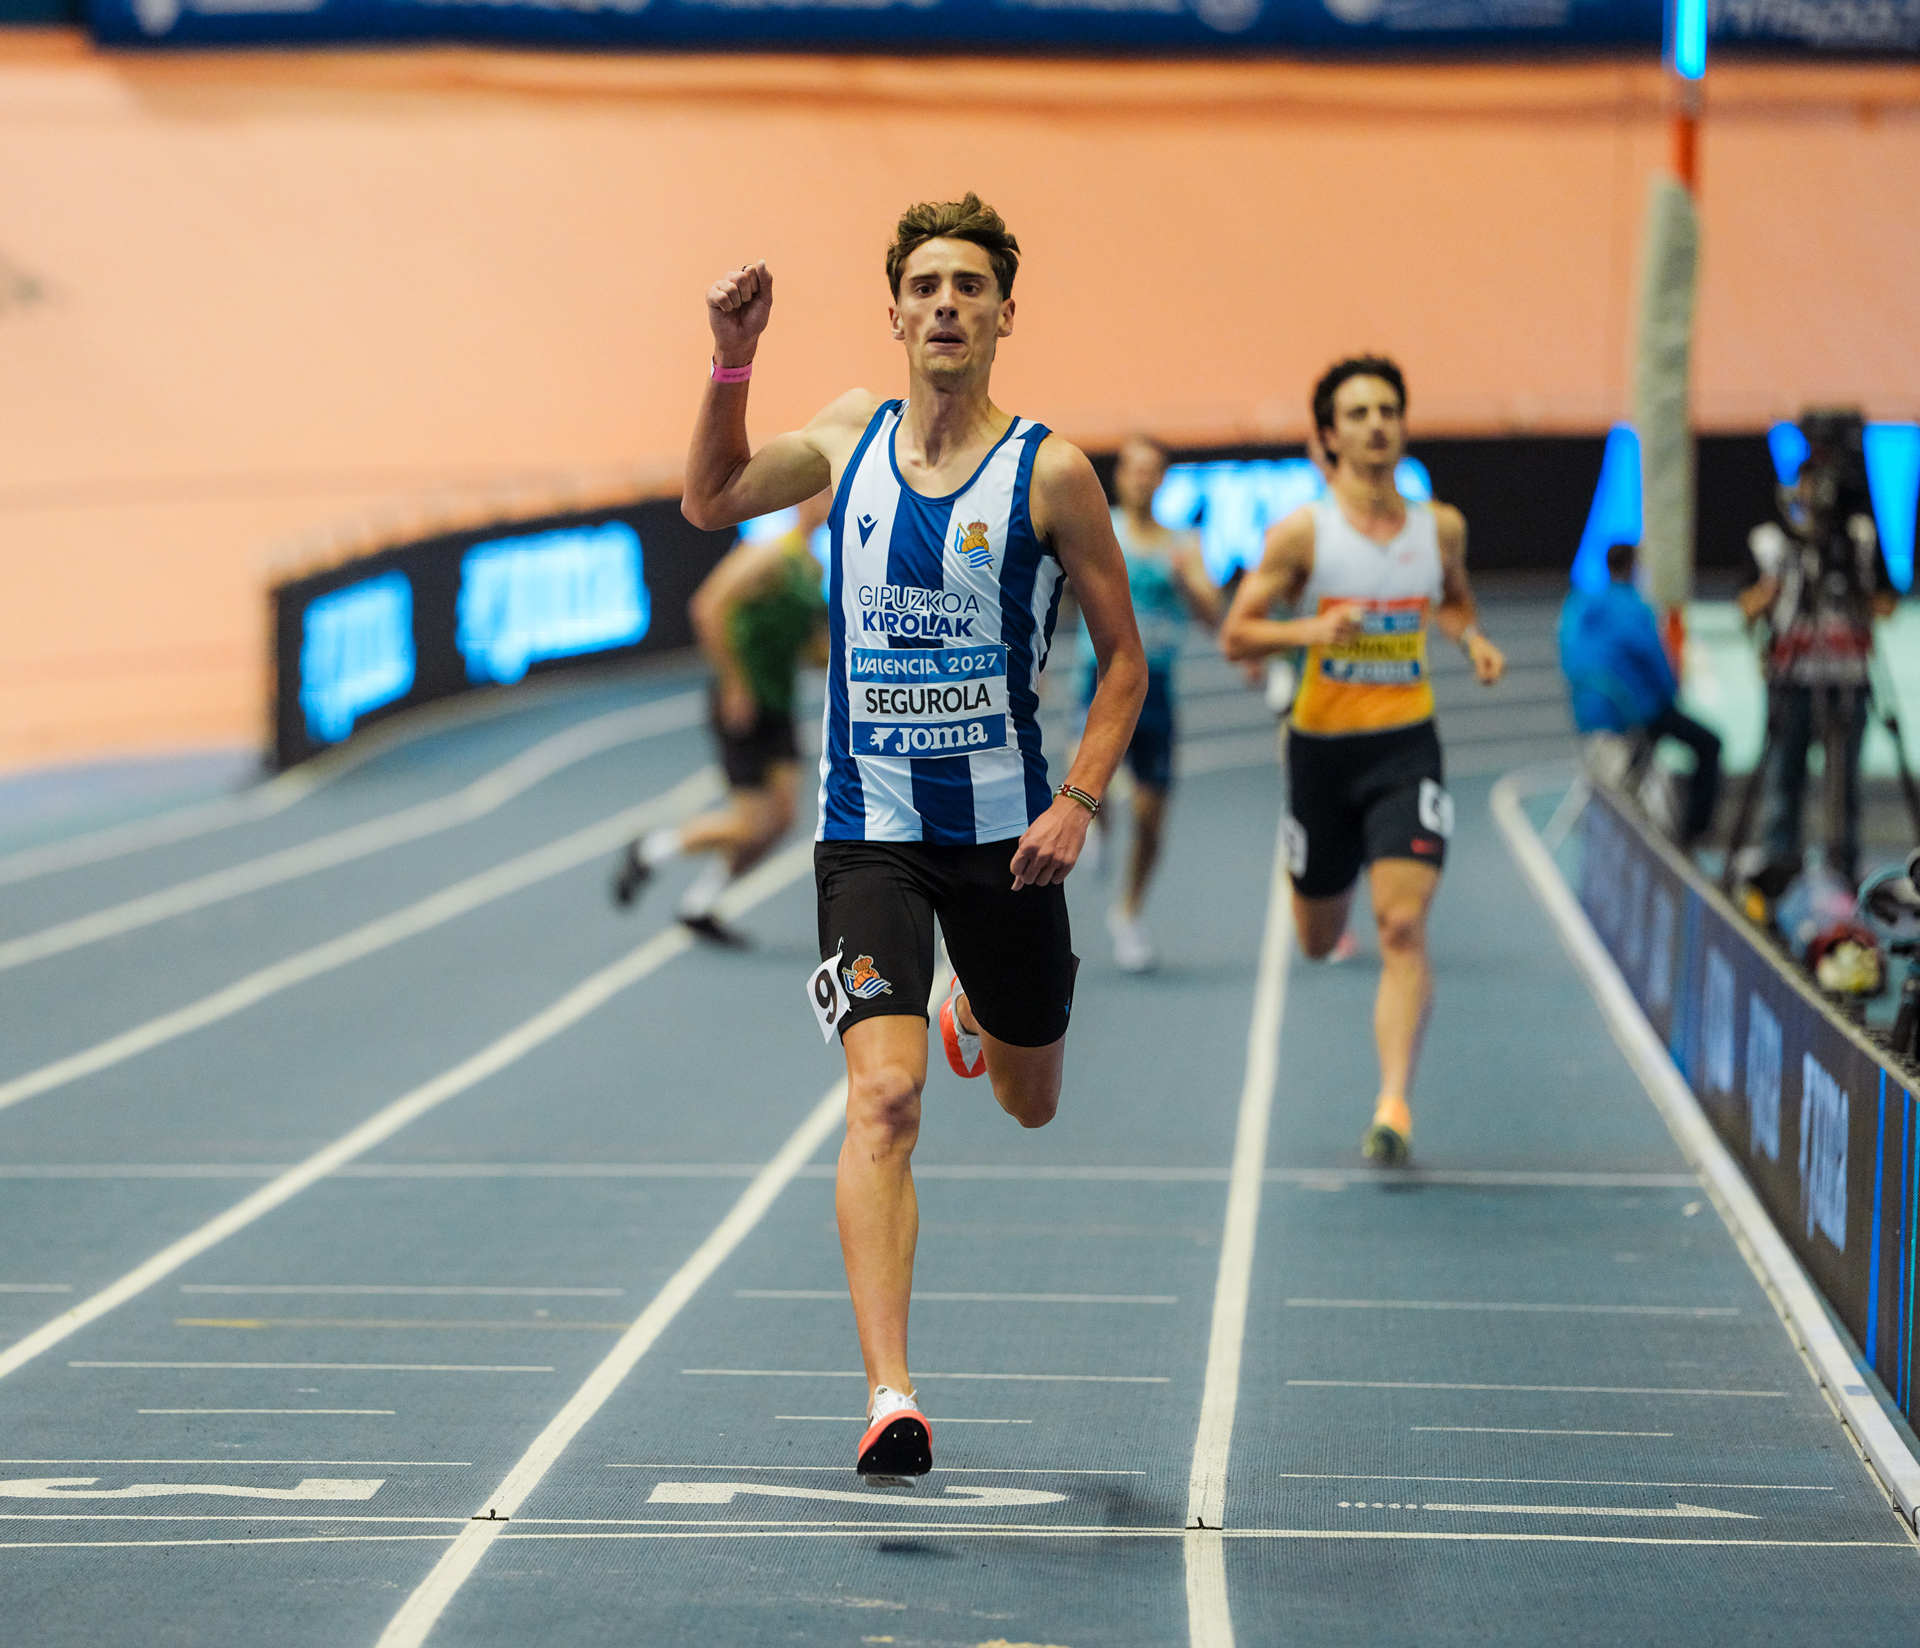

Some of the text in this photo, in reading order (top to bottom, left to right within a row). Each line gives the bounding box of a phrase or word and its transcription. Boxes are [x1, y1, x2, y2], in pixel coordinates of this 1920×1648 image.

[858, 585, 980, 613] GIPUZKOA
[863, 612, 974, 637] KIROLAK
[856, 653, 998, 675] VALENCIA 2027
[865, 683, 991, 714] SEGUROLA
[895, 722, 988, 753] Joma
[816, 970, 838, 1024] 9
[645, 1482, 1069, 1507] 2
